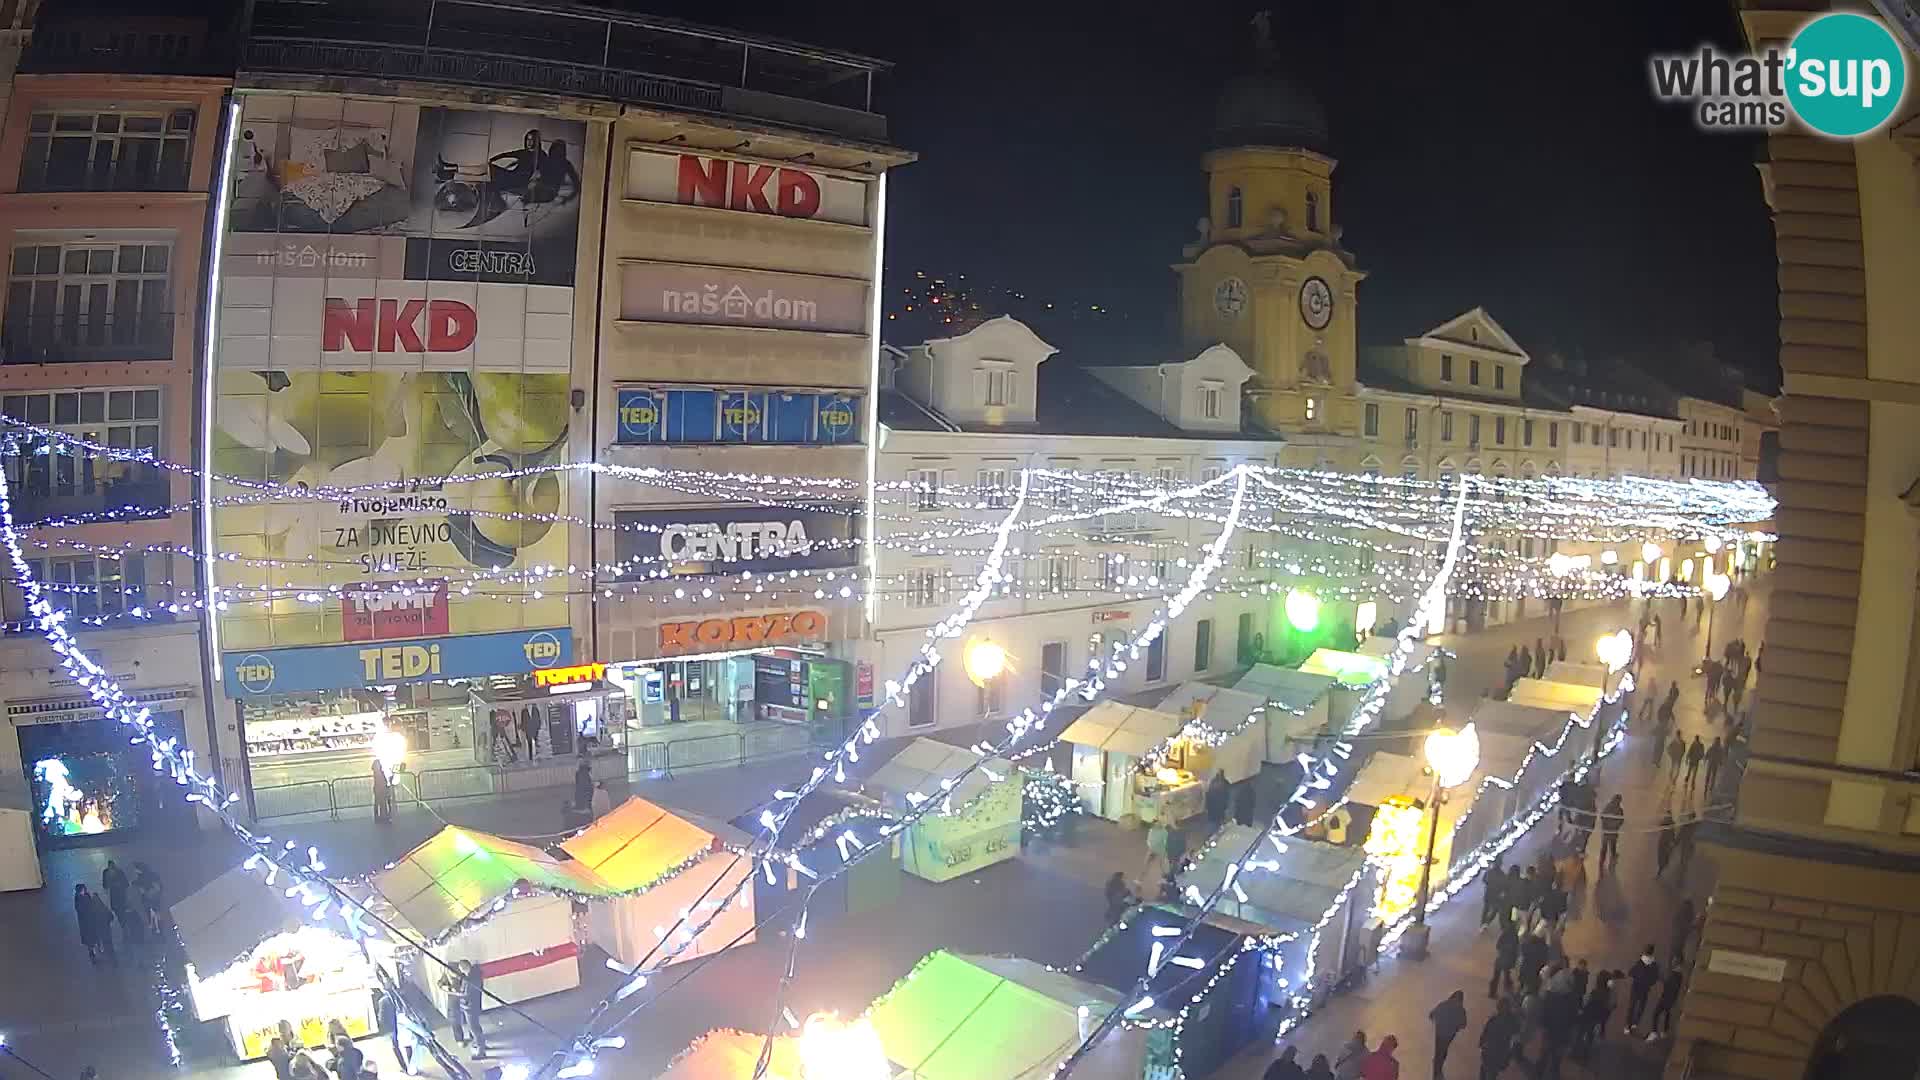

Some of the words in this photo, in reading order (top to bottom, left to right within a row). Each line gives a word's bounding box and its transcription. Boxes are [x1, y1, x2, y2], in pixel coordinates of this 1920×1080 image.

[677, 155, 820, 219] NKD
[449, 249, 536, 277] CENTRA
[662, 284, 719, 315] naš
[755, 290, 817, 323] dom
[322, 297, 477, 353] NKD
[335, 528, 358, 548] ZA
[371, 522, 452, 546] DNEVNO
[660, 520, 811, 562] CENTRA
[660, 611, 828, 651] KORZO
[360, 644, 440, 681] TEDi
